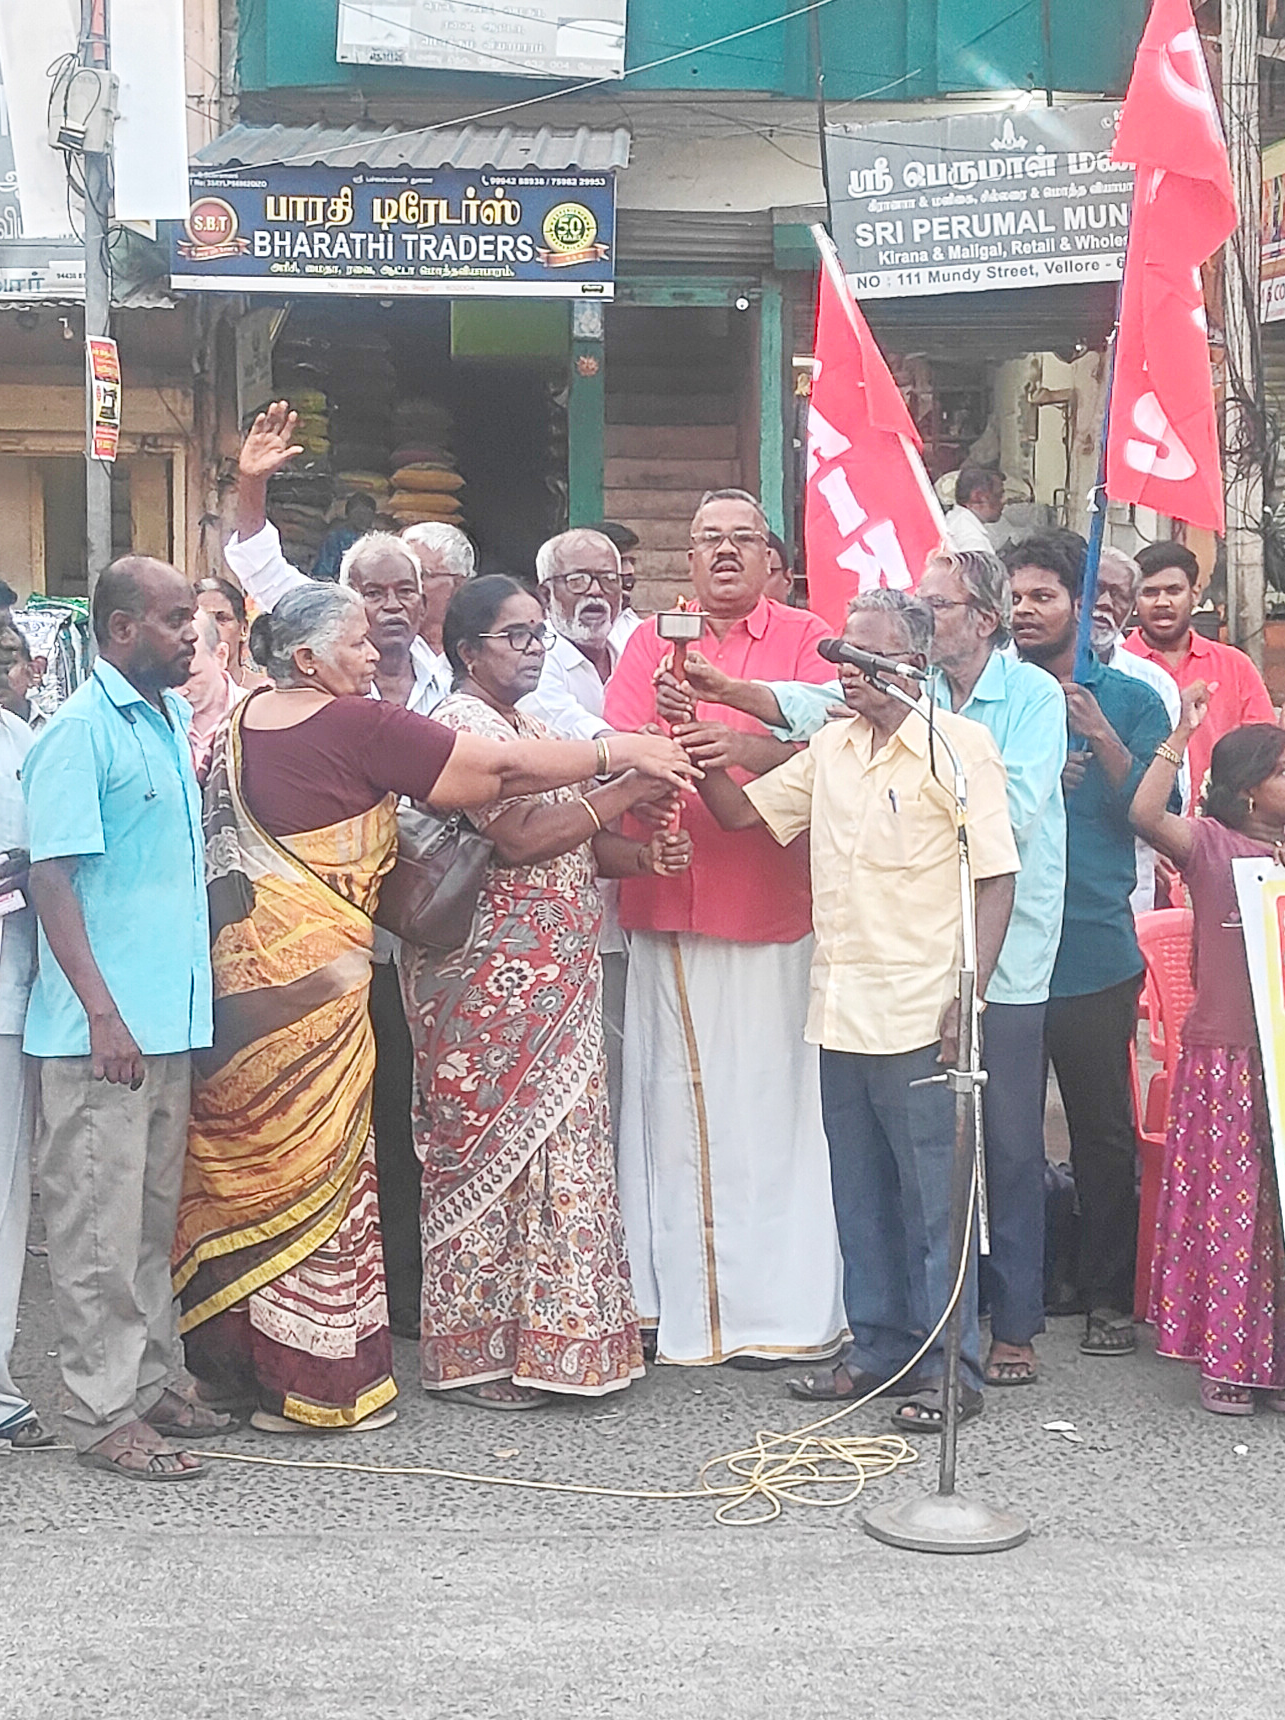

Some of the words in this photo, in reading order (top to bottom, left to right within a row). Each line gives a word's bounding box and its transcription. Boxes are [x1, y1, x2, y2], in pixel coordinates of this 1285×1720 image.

[903, 145, 1058, 190] பெருமாள்
[194, 215, 230, 233] S.B.T
[266, 186, 355, 232] பாரதி
[372, 186, 522, 232] டிரேடர்ஸ்
[557, 217, 583, 235] 50
[855, 221, 904, 248] SRI
[912, 209, 1056, 244] PERUMAL
[1063, 203, 1129, 231] MUN
[253, 230, 395, 260] BHARATHI
[401, 233, 535, 263] TRADERS
[878, 248, 929, 266] Kirana
[932, 247, 946, 262] &
[947, 241, 1008, 262] Maligal,
[1011, 238, 1056, 257] Retail
[1059, 236, 1072, 251] &
[856, 276, 881, 290] NO
[897, 272, 923, 287] 111
[927, 268, 981, 285] Mundy
[986, 264, 1039, 281] Street,
[1044, 258, 1101, 275] Vellore
